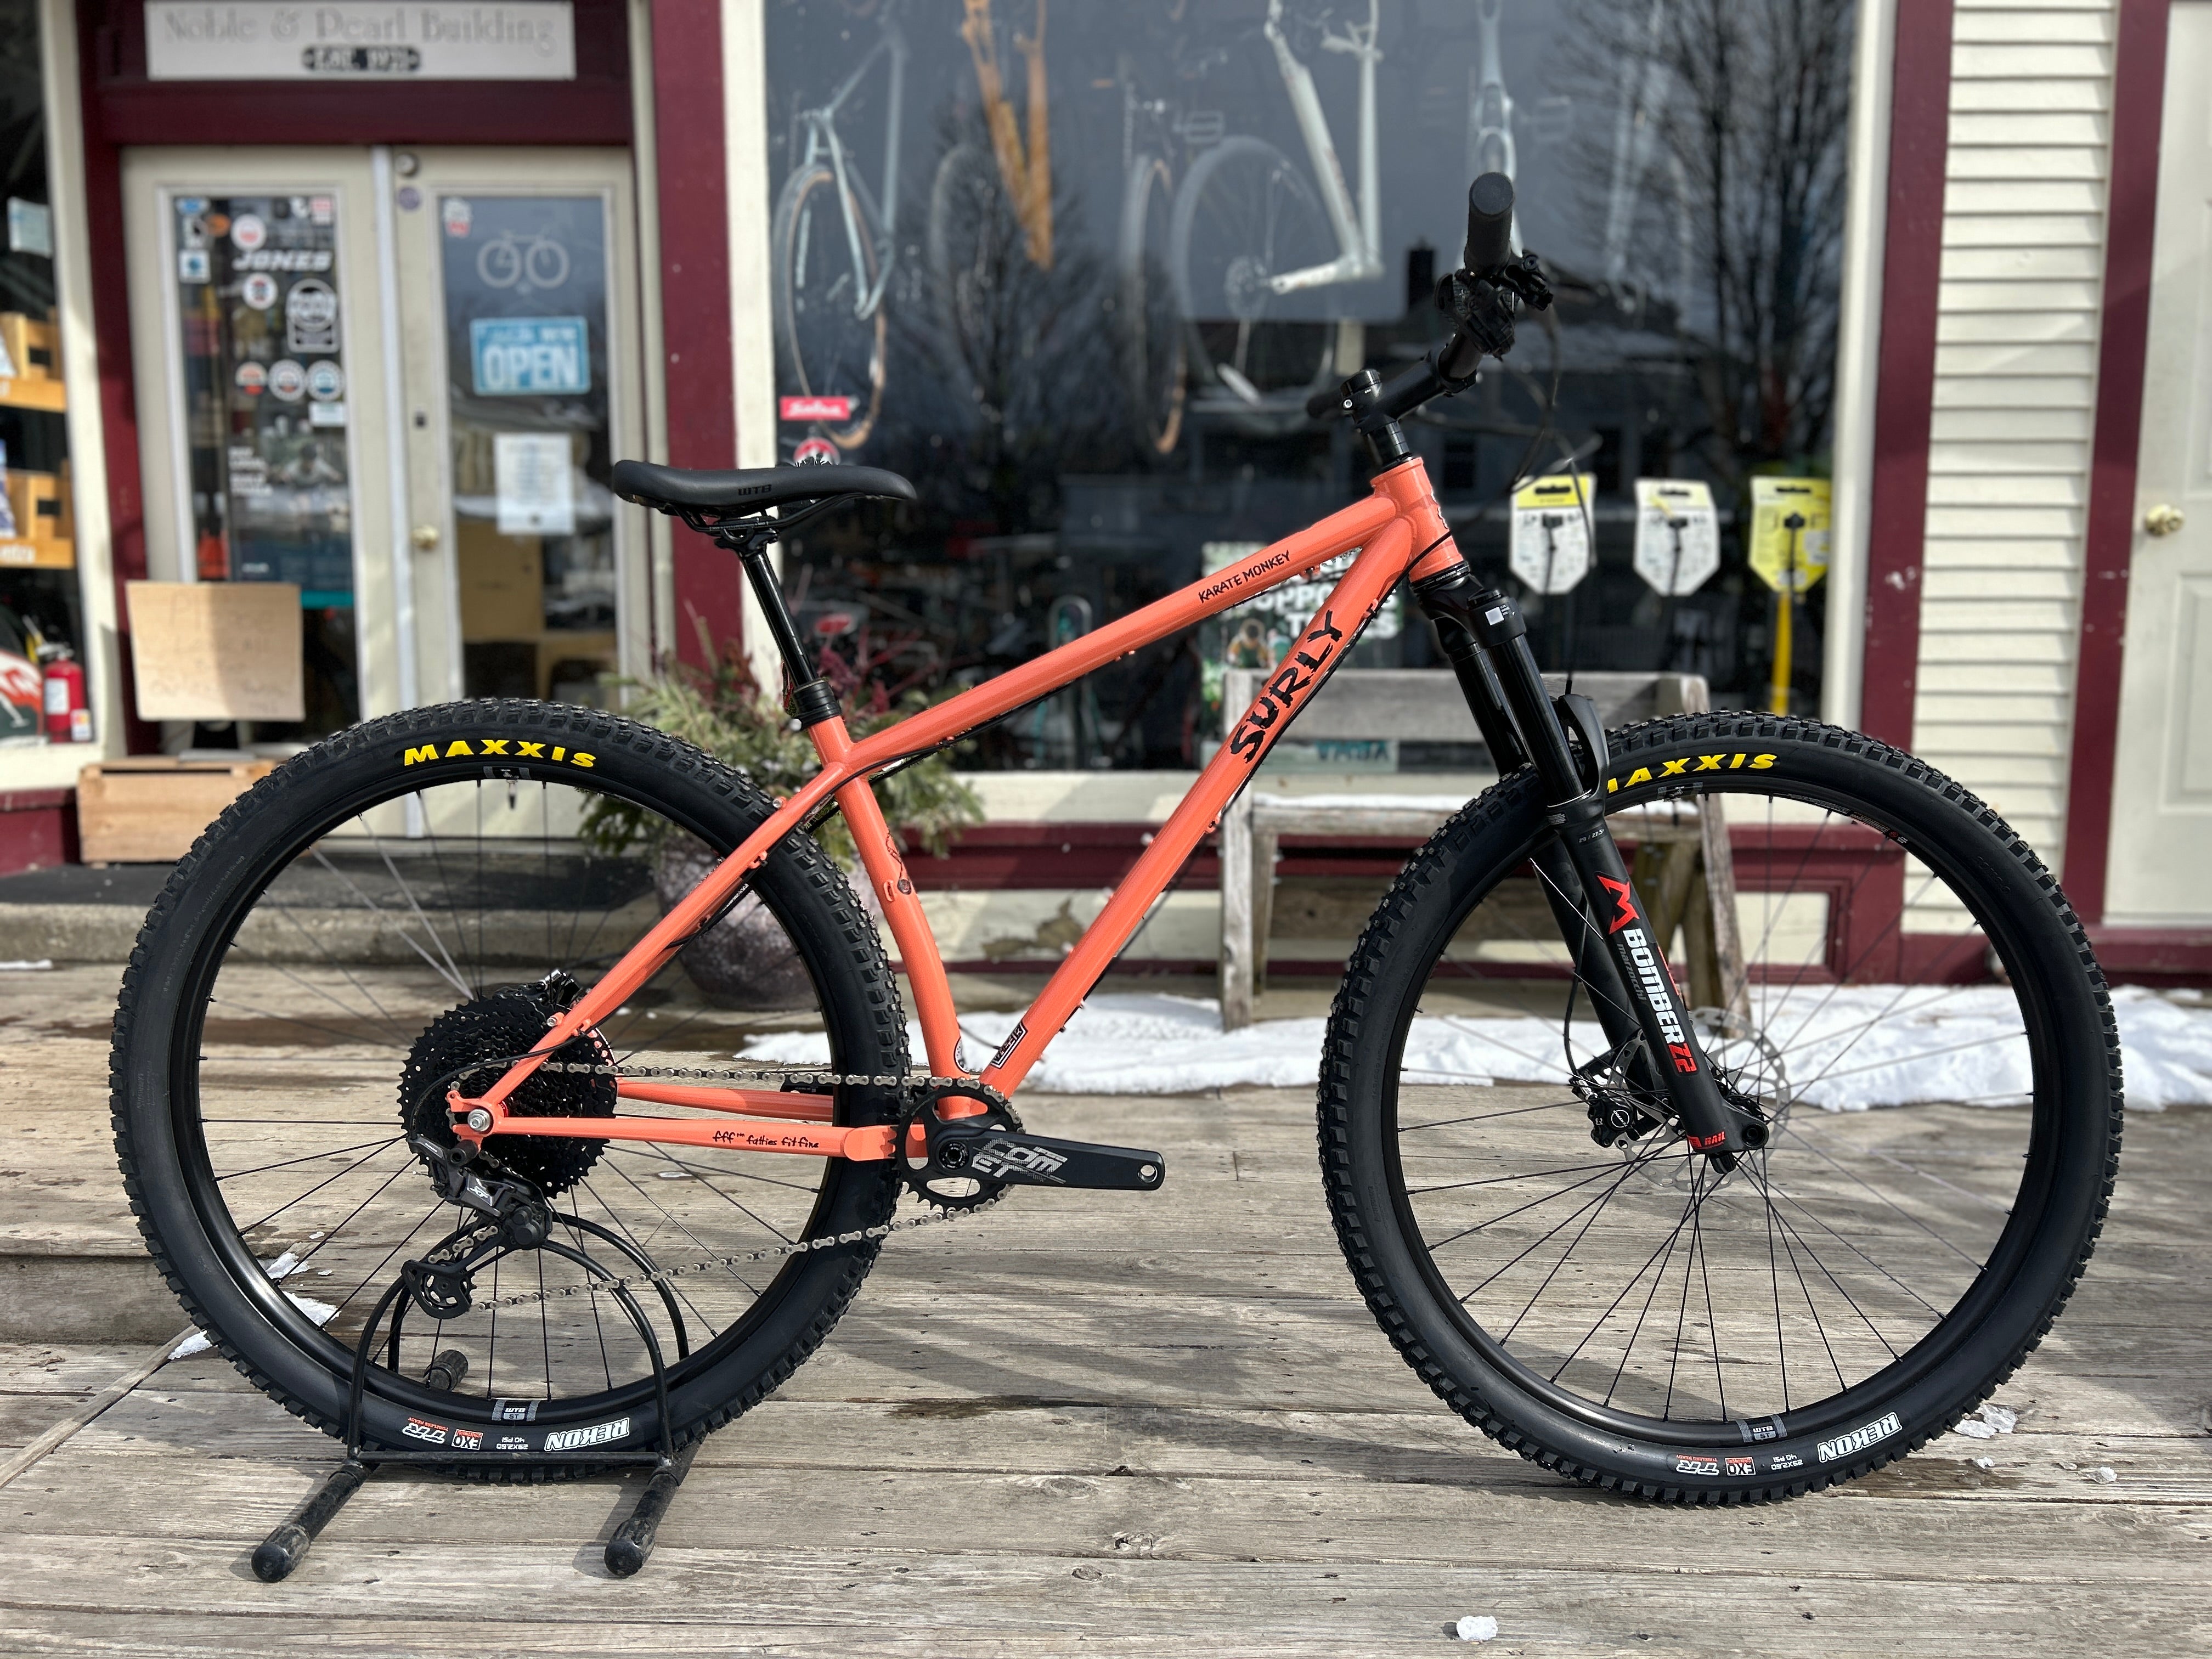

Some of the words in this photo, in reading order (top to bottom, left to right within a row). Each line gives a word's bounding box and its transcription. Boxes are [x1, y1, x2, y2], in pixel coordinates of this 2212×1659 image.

[315, 7, 406, 42] Pearl
[421, 7, 558, 58] Building
[232, 250, 333, 271] JONES
[483, 345, 579, 390] OPEN
[738, 484, 772, 496] WTB
[1198, 572, 1244, 603] KARATE
[1242, 550, 1291, 583] MONKEY
[1230, 610, 1343, 764] SURLY
[404, 740, 596, 768] MAXXIS
[1616, 942, 1646, 1001] marzocchi
[746, 1134, 777, 1146] fatties
[452, 1434, 481, 1449] EXO
[544, 1417, 630, 1451] REKON
[1817, 1411, 1902, 1463] REKON
[1726, 1463, 1755, 1475] EXO
